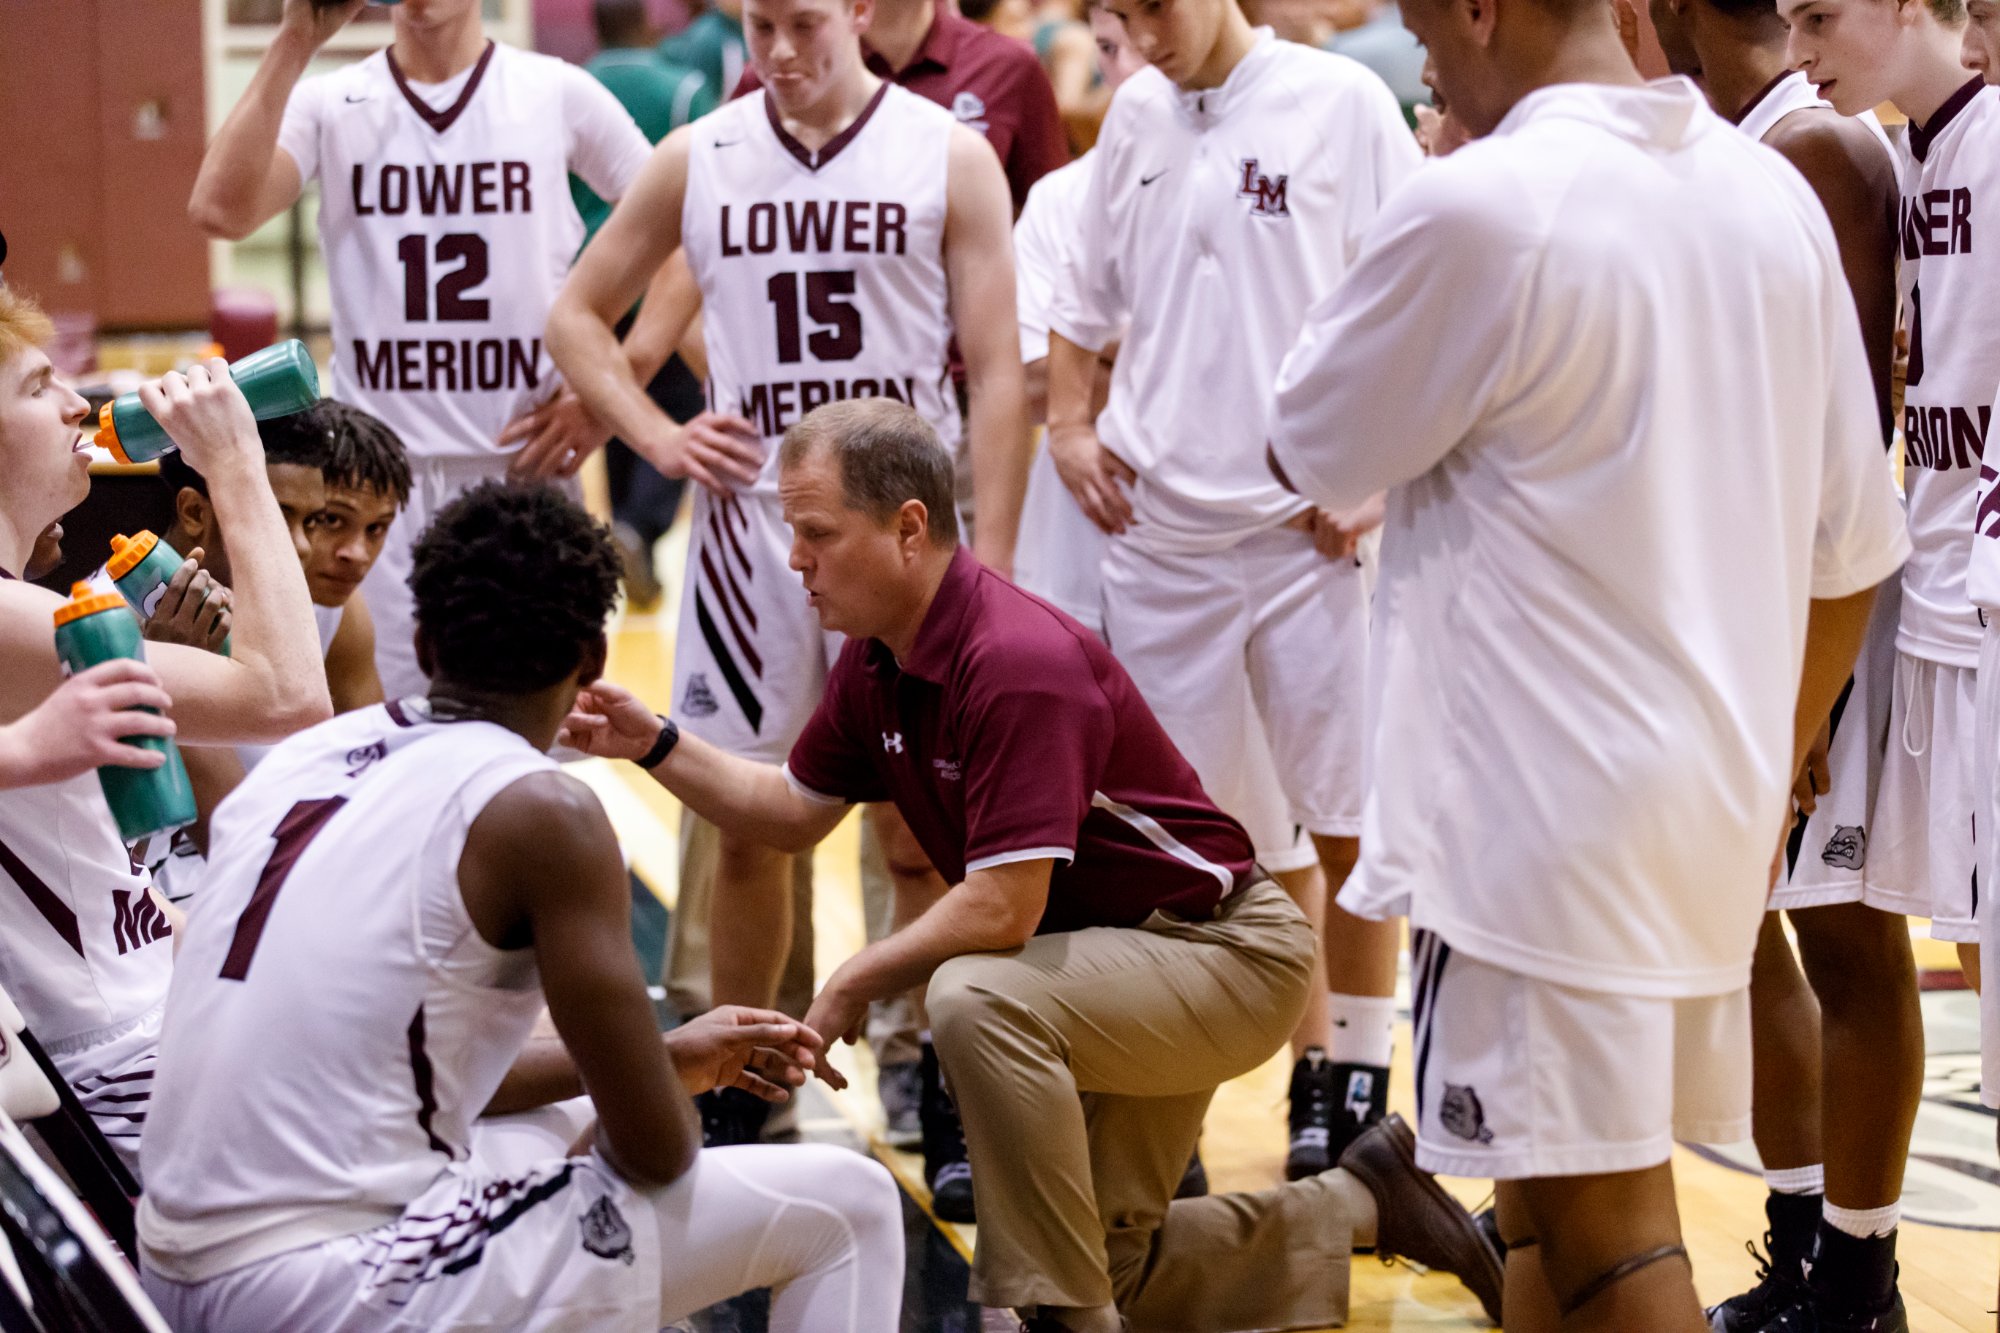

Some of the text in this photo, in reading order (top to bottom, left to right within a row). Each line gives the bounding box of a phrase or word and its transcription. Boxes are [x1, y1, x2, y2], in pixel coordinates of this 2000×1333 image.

[352, 161, 532, 217] LOWER
[720, 201, 906, 257] LOWER
[398, 233, 490, 322] 12
[768, 270, 863, 364] 15
[353, 338, 541, 391] MERION
[218, 795, 349, 981] 1
